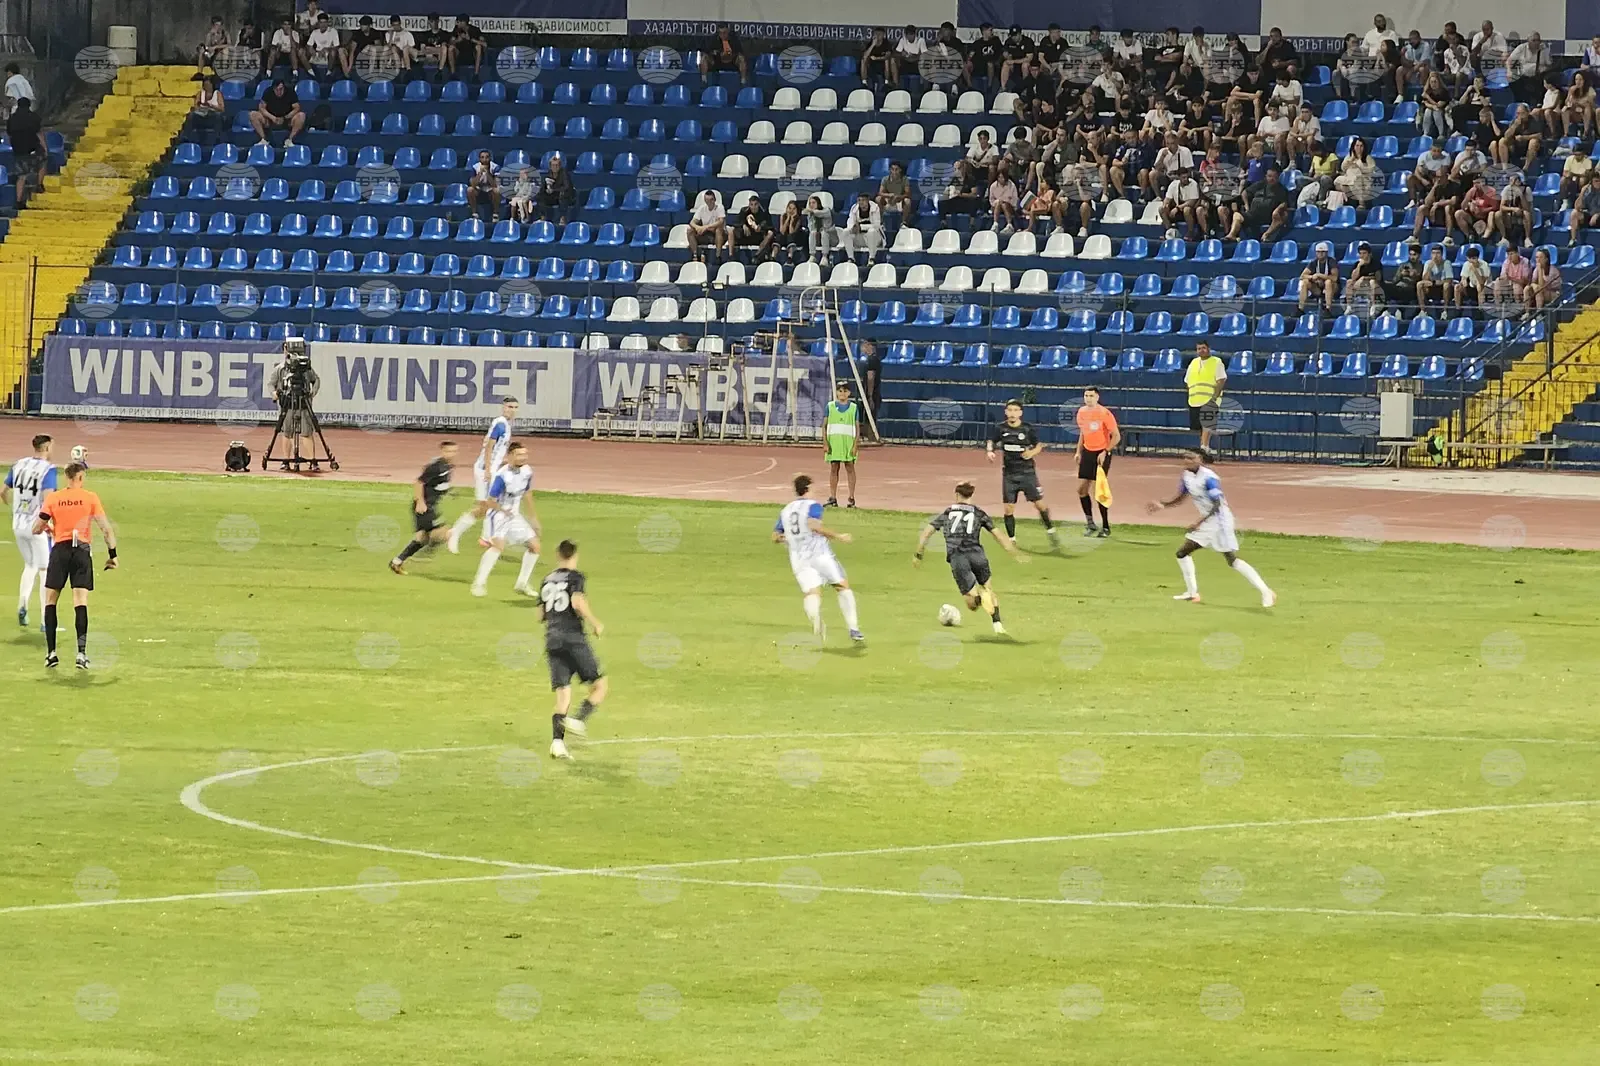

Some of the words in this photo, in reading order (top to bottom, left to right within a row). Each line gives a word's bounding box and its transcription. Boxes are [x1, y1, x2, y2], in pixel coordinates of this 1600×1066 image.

[538, 21, 612, 33] ЗАВИСИМОСТ
[644, 22, 699, 35] ХАЗАРТЪТ
[734, 24, 763, 36] РИСК
[766, 25, 780, 36] ОТ
[783, 26, 845, 38] РАЗВИВАНЕ
[849, 27, 863, 38] НА
[866, 27, 940, 40] ЗИСОСТ
[69, 347, 285, 399] WINBET
[336, 355, 548, 405] WINBET
[598, 361, 809, 414] WINBET
[235, 410, 278, 420] ЗАВИСИМ
[948, 511, 975, 534] 71
